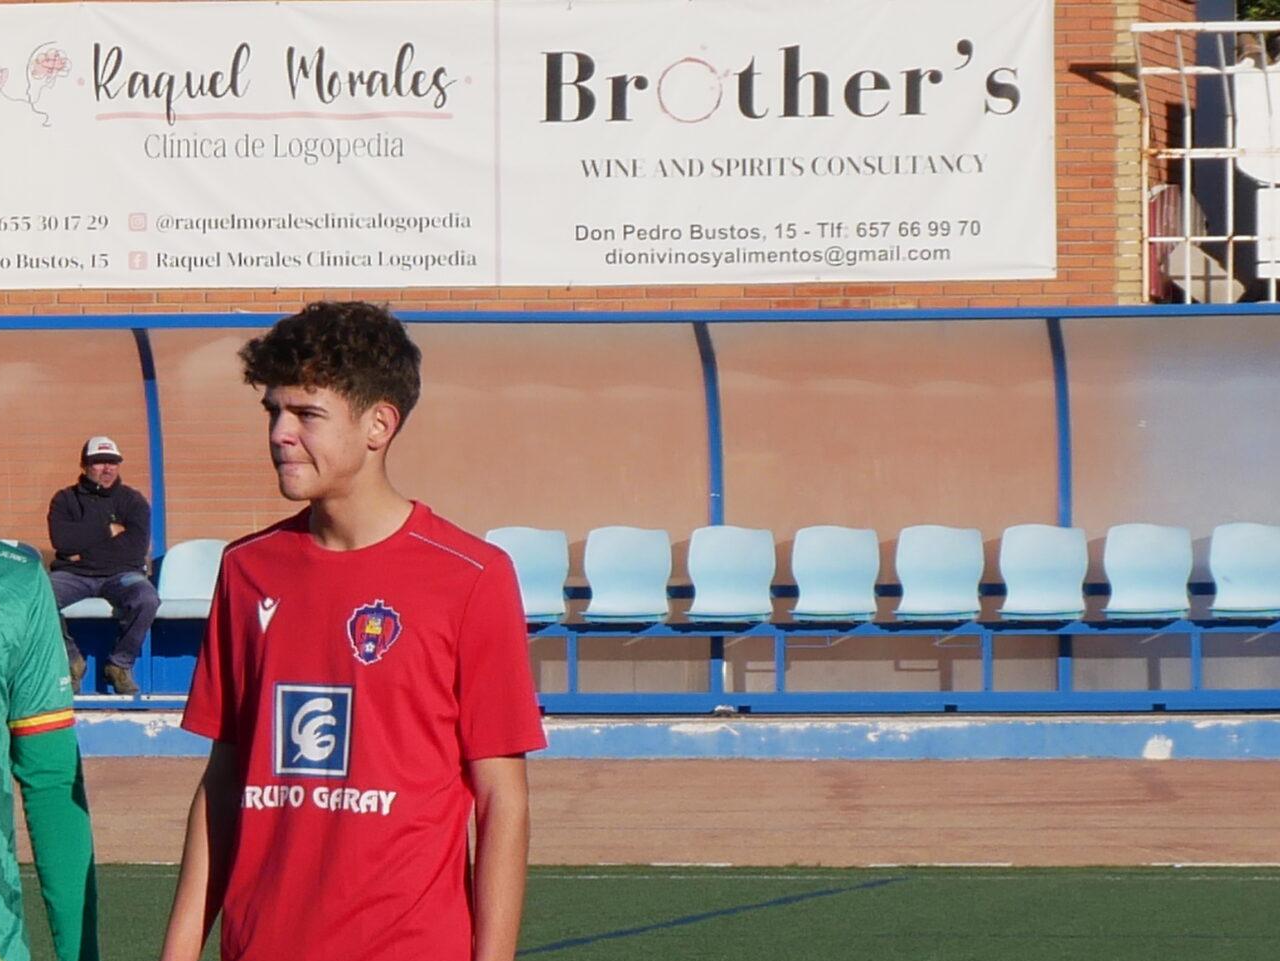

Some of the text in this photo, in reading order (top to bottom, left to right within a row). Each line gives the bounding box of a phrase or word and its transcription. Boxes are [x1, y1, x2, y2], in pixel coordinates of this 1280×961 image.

[92, 42, 458, 126] Raquel Morales
[144, 131, 404, 165] Clínica de Logopedia
[581, 154, 987, 178] WINE AND SPIRITS CONSULTANCY
[87, 215, 109, 231] 29
[156, 213, 472, 233] @raquelmoralesclinicalogopedia
[575, 225, 615, 241] Don
[623, 224, 682, 241] Pedro
[690, 223, 766, 242] Bustos,
[774, 223, 797, 239] 15
[856, 222, 889, 238] 657
[898, 221, 921, 237] 66
[927, 221, 951, 237] 99
[957, 220, 981, 236] 70
[16, 253, 84, 271] Bustos,
[90, 253, 109, 269] 15
[156, 252, 221, 272] Raquel
[227, 251, 302, 268] Morales
[378, 250, 478, 271] Logopedia
[604, 245, 951, 267] dionivinosyalimentos@gmail.com
[241, 785, 397, 816] RUPO GARAY
